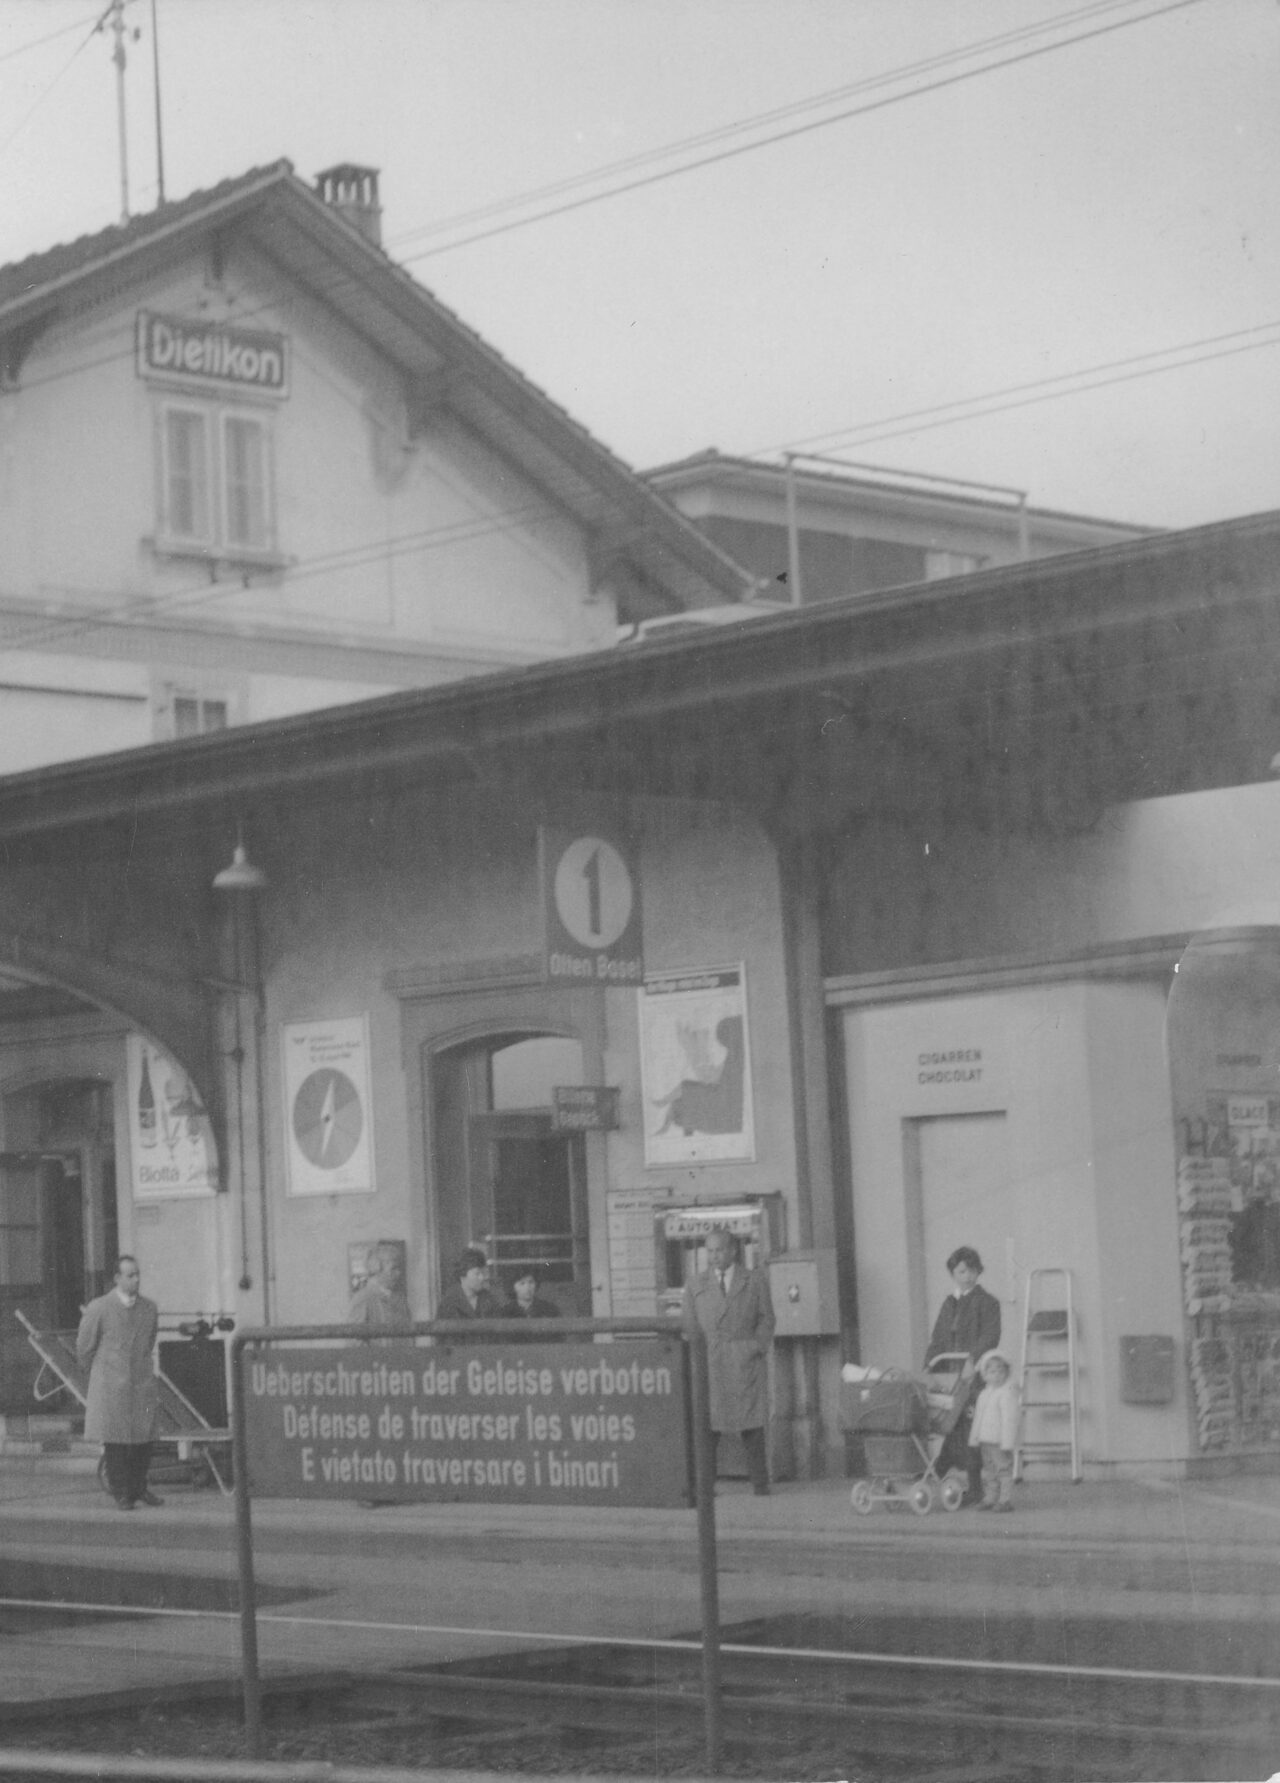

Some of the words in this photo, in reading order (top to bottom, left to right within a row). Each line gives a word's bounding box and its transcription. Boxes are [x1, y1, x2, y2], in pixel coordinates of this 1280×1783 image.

[151, 323, 283, 384] Dietikon
[582, 847, 602, 936] 1
[549, 953, 592, 977] Olten
[597, 955, 641, 979] Basel
[919, 1048, 982, 1066] CIGARREN
[919, 1068, 983, 1085] CHOCOLAT
[677, 1219, 738, 1233] AUTOMAT
[252, 1362, 415, 1396] Ueberschreiten
[422, 1361, 460, 1396] der
[467, 1359, 553, 1396] Geleise
[561, 1359, 671, 1396] verboten
[378, 1403, 403, 1440] de
[411, 1406, 519, 1440] traverser
[526, 1404, 562, 1441] les
[570, 1404, 637, 1441] voies
[301, 1447, 315, 1482] E
[321, 1448, 397, 1483] vietato
[402, 1451, 526, 1486] traversare
[533, 1450, 542, 1487] i
[548, 1451, 619, 1488] binari
